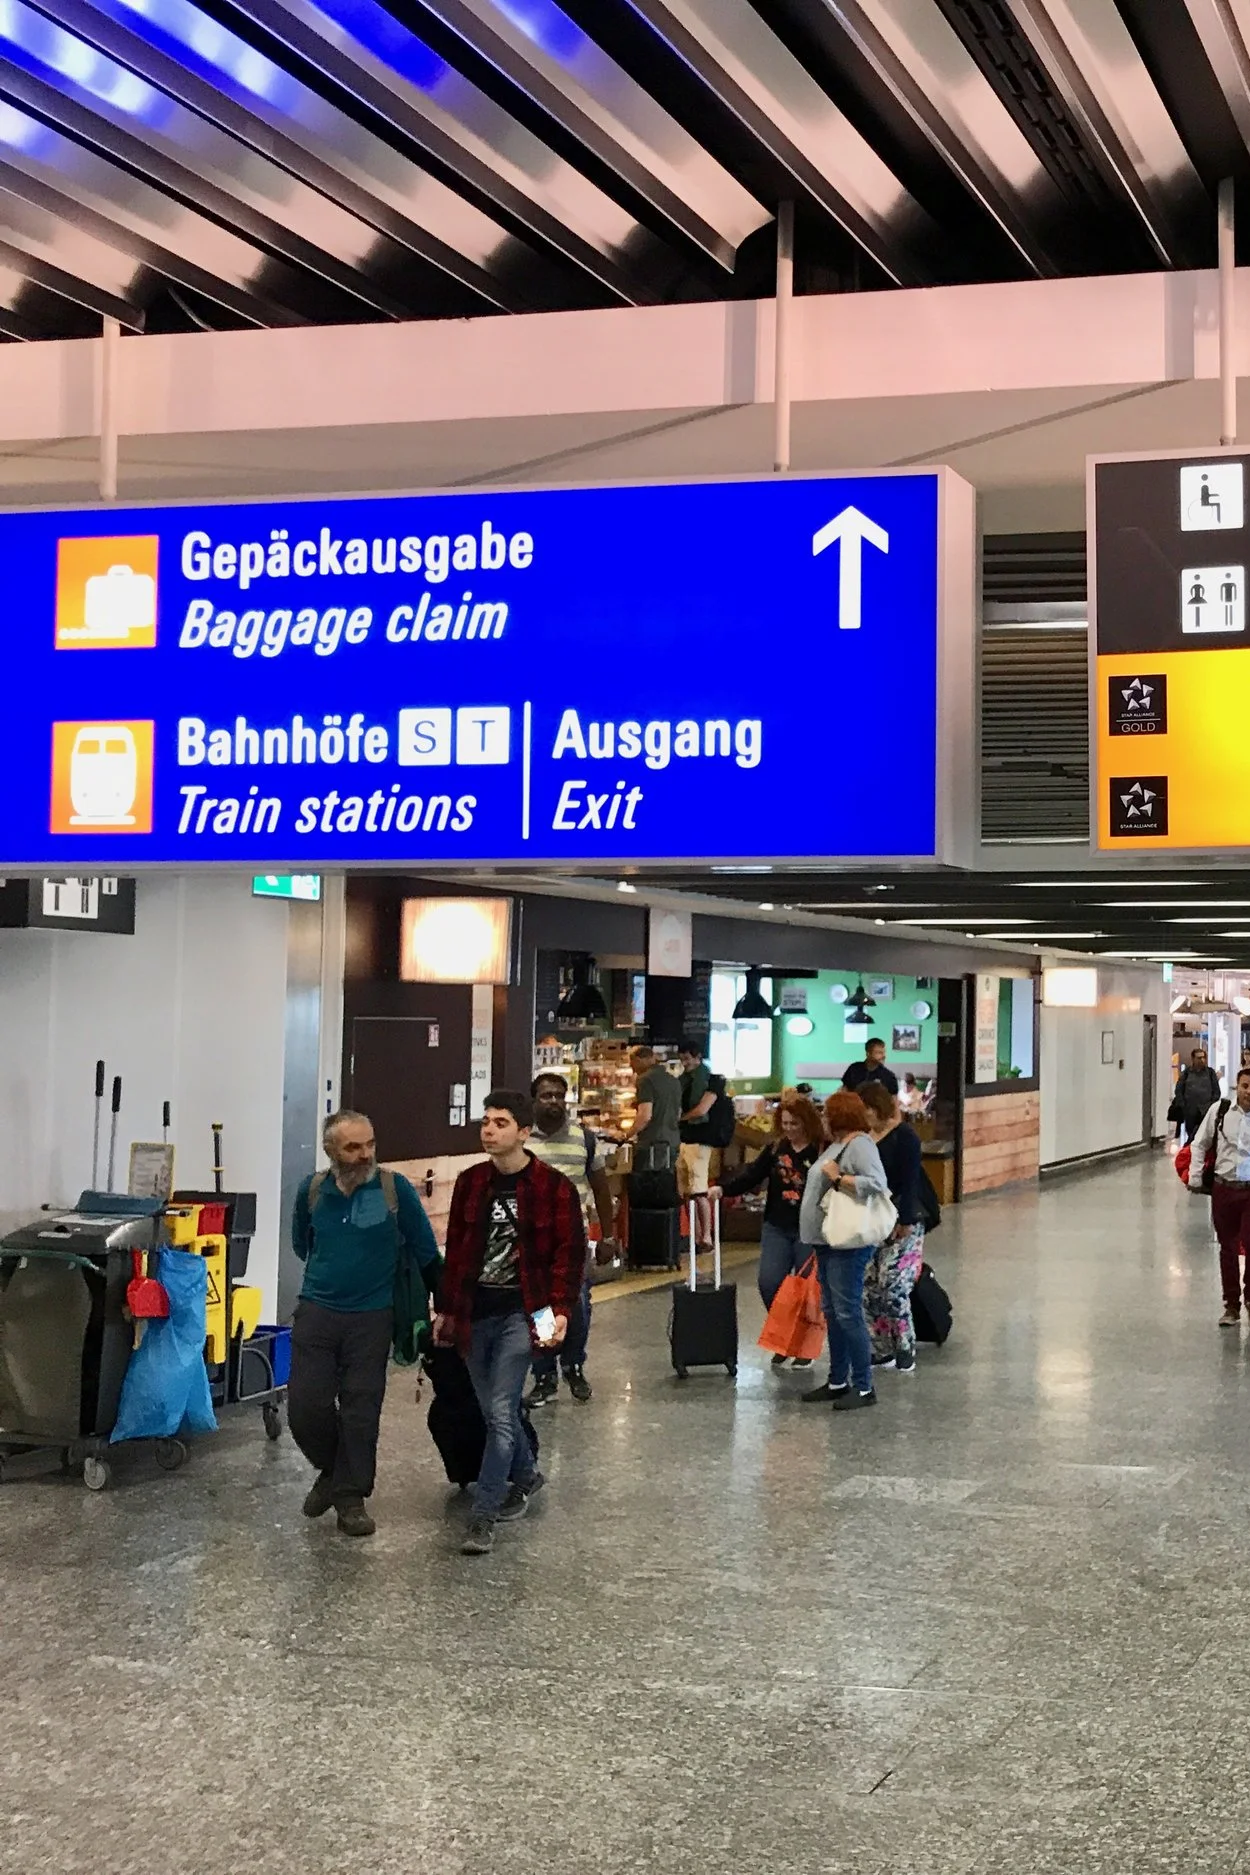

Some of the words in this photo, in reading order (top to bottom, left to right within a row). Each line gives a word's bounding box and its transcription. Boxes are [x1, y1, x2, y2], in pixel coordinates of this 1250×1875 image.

[181, 521, 533, 591] Gepäckausgabe
[178, 603, 372, 658] Baggage
[387, 591, 509, 643] claim
[178, 714, 389, 766] Bahnhöfe
[413, 720, 437, 754] S
[471, 719, 496, 752] T
[551, 708, 762, 770] Ausgang
[1121, 722, 1156, 733] GOLD
[177, 784, 282, 834] Train
[294, 783, 477, 834] stations
[551, 780, 644, 830] Exit
